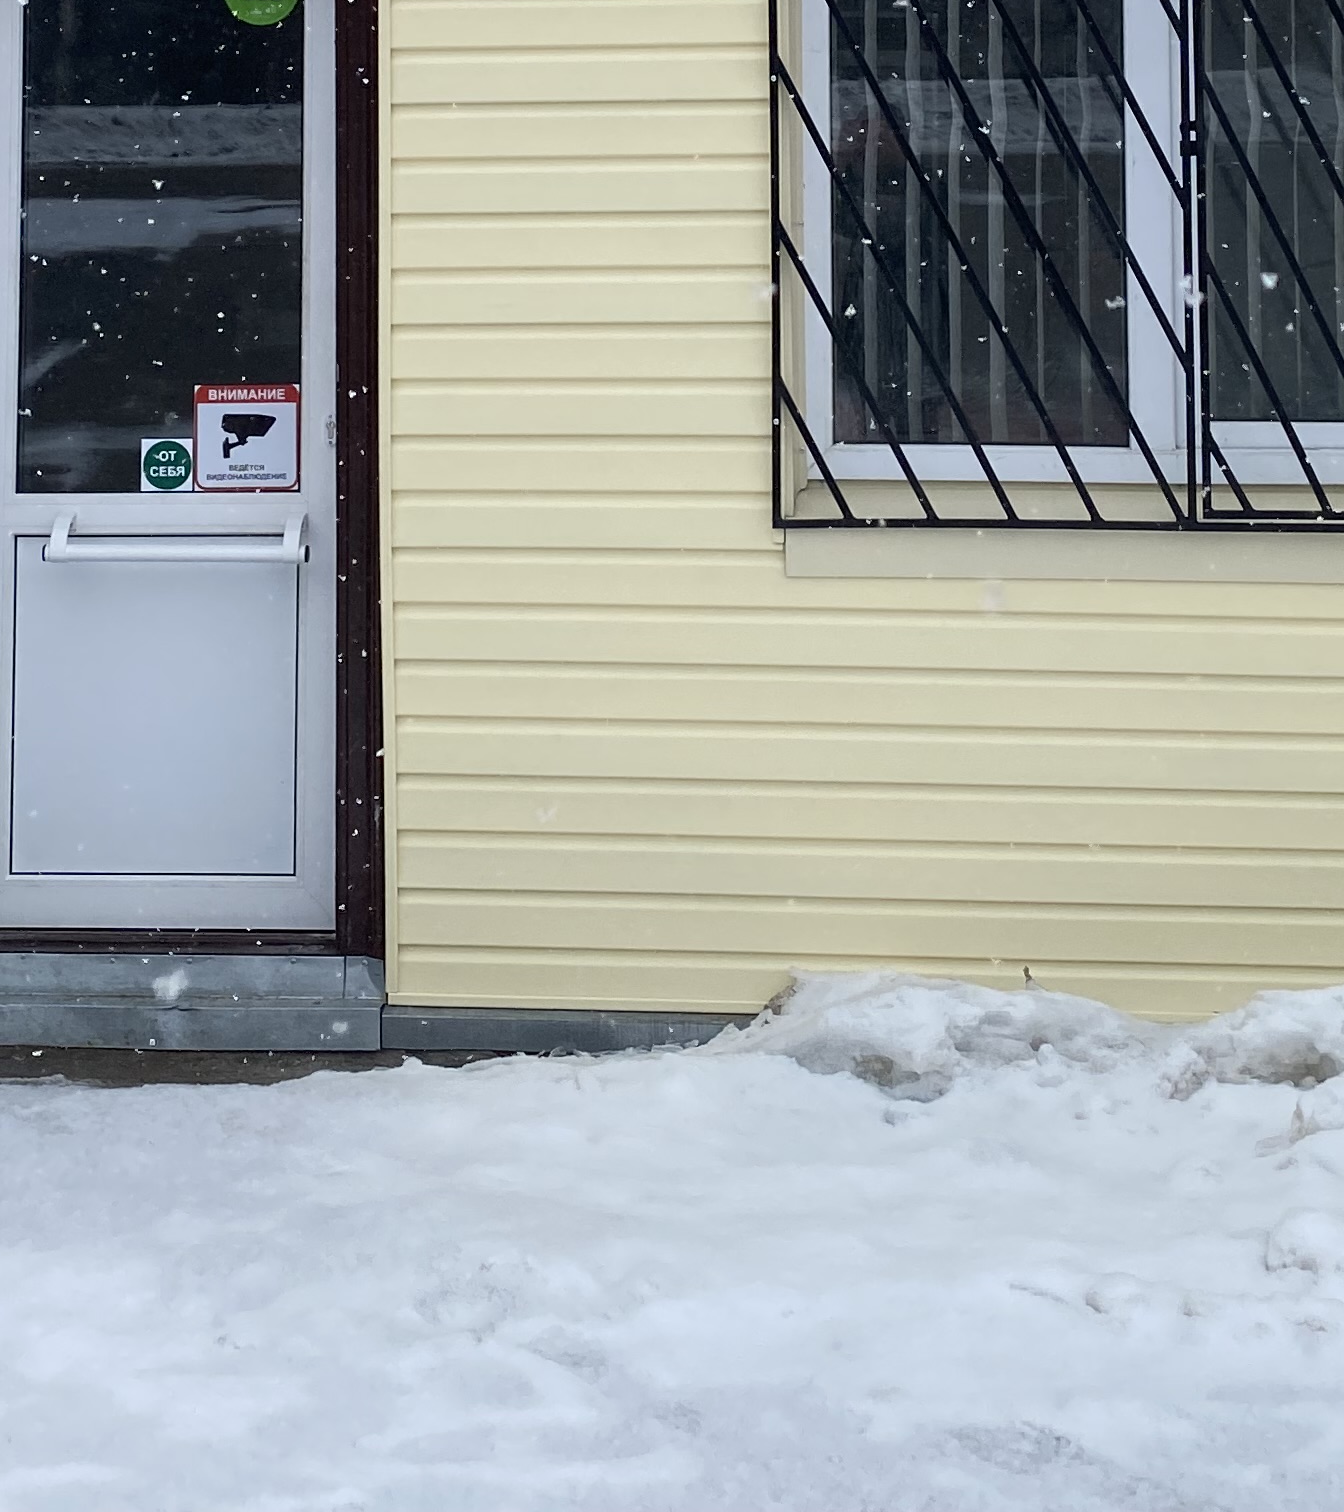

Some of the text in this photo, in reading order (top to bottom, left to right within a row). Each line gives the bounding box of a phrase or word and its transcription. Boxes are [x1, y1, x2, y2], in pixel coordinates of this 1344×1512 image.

[208, 388, 286, 401] ВНИМАНИЕ
[158, 450, 177, 462] ОТ
[149, 465, 186, 477] СЕБЯ
